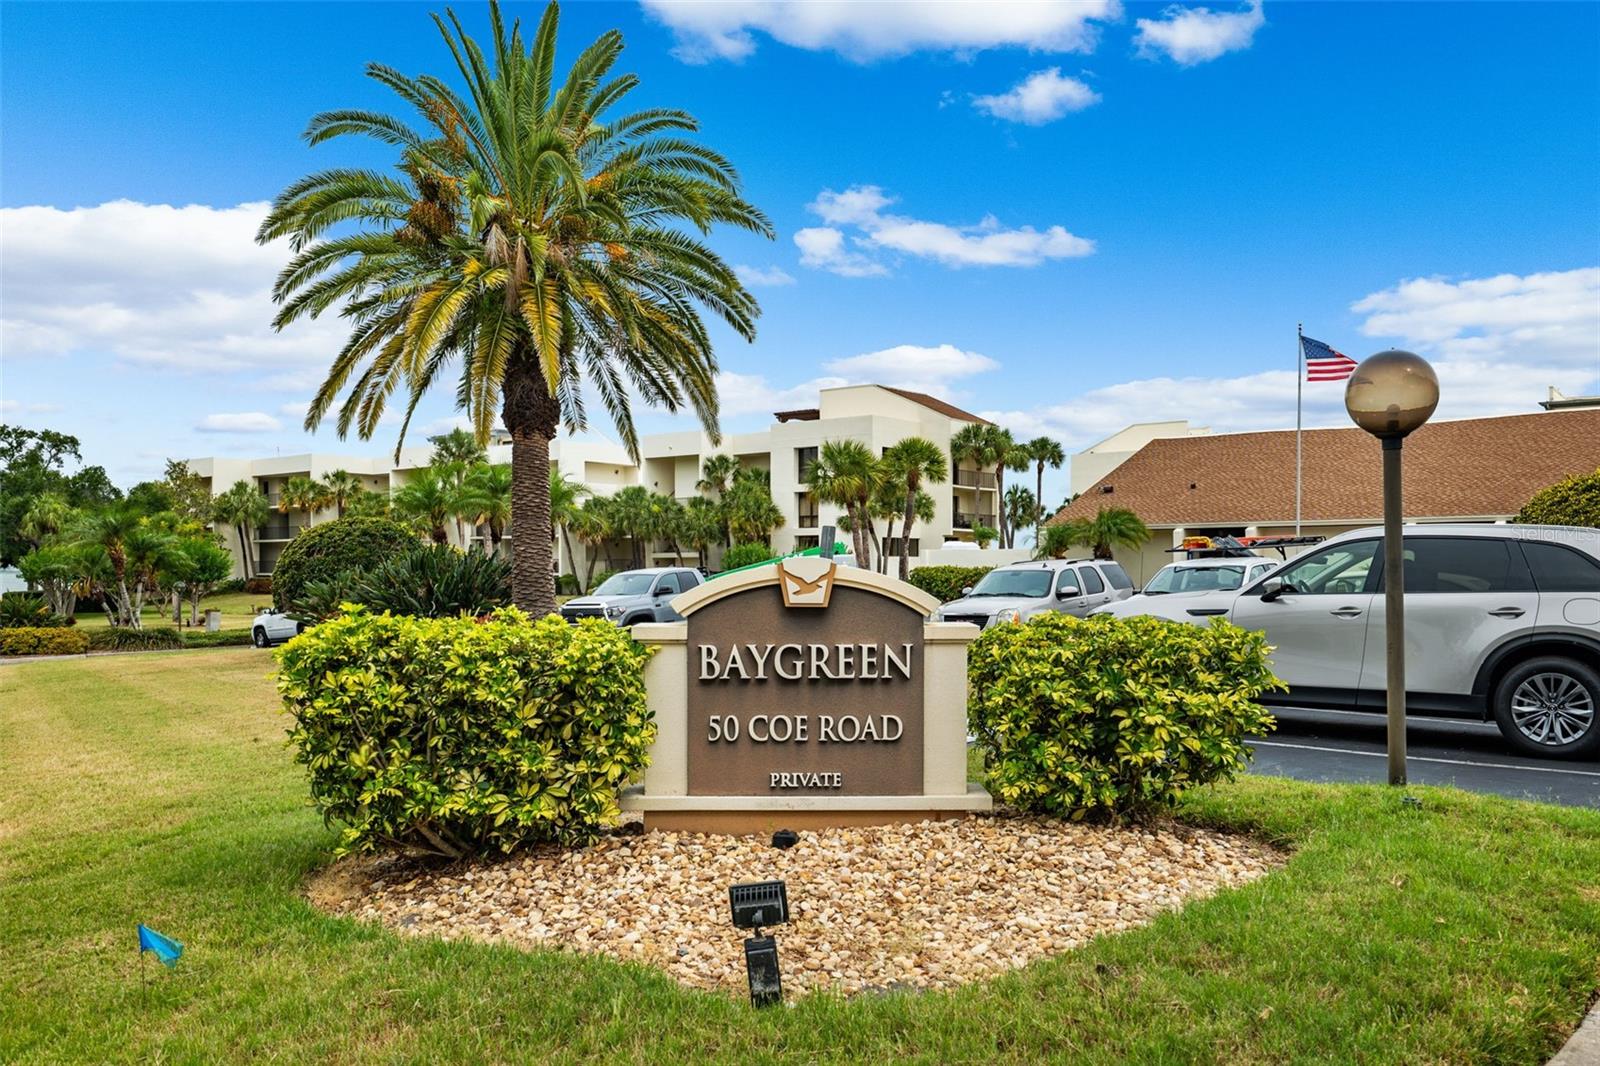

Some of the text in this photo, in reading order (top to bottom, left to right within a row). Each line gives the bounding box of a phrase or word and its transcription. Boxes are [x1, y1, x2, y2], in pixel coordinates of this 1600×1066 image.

[697, 643, 914, 680] BAYGREEN
[707, 714, 904, 742] 50 COE ROAD
[769, 772, 842, 788] PRIVATE
